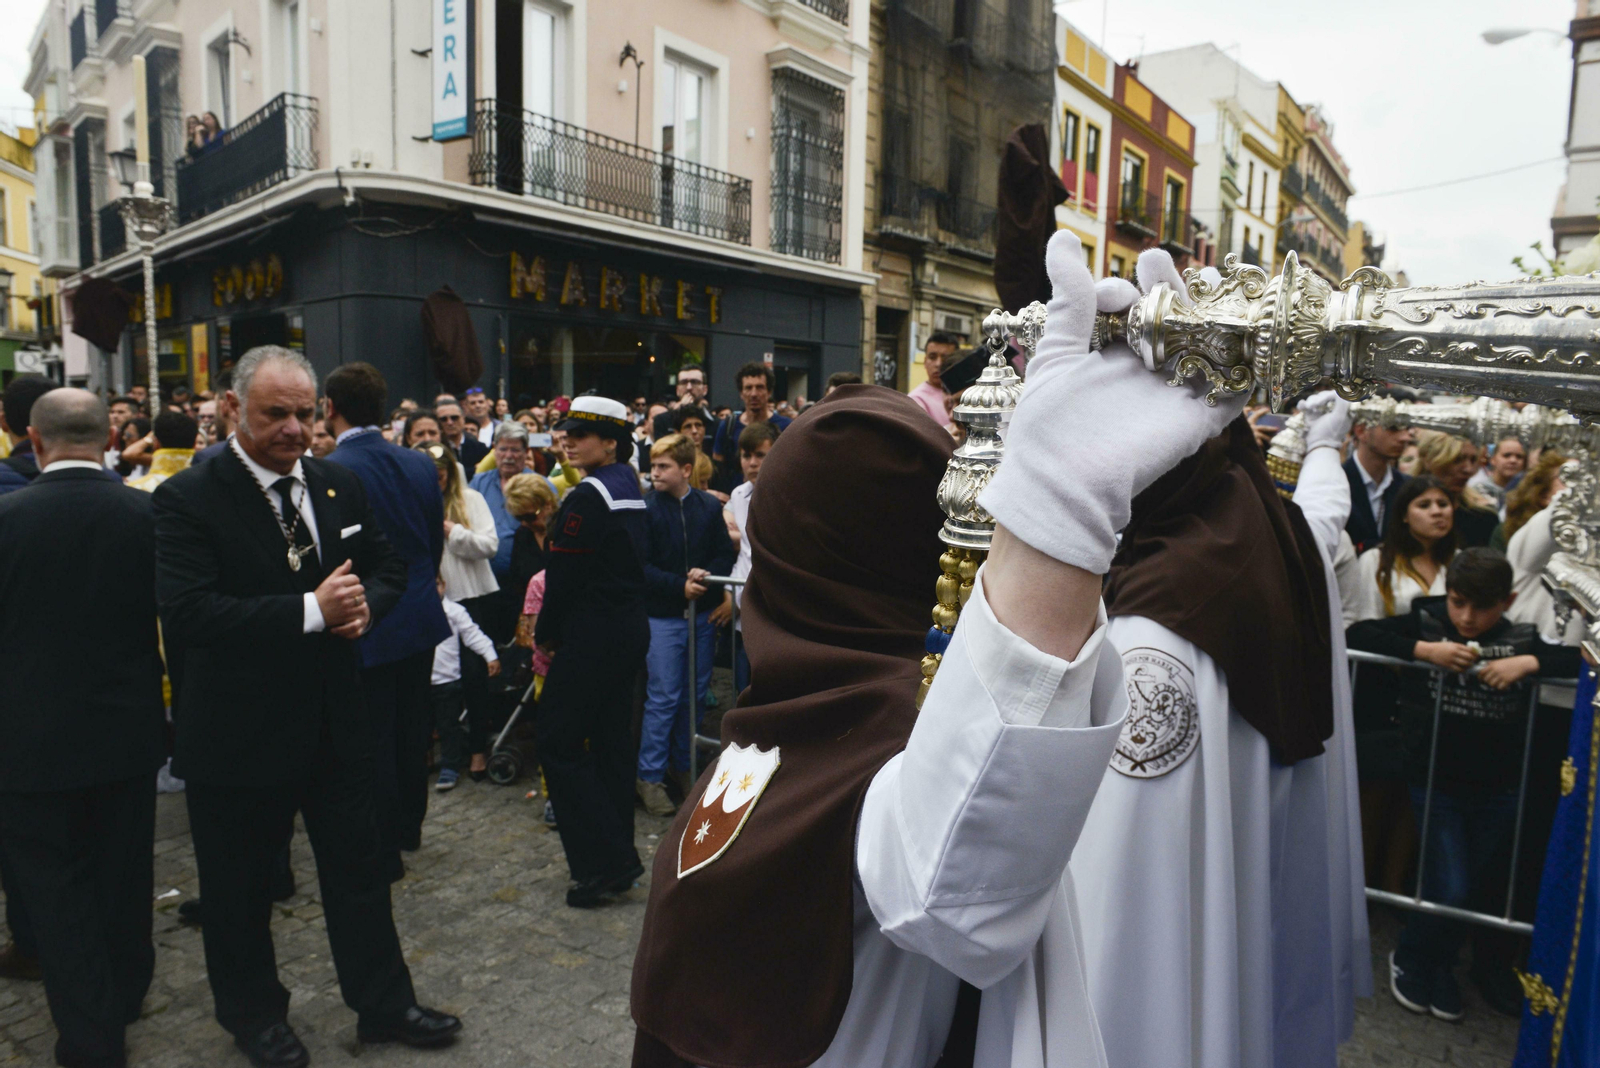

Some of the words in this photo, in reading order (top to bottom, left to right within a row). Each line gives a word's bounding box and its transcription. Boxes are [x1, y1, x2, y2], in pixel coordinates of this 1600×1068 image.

[213, 253, 283, 307] FOOD
[511, 251, 723, 323] MARKET
[1151, 658, 1173, 672] MARIA
